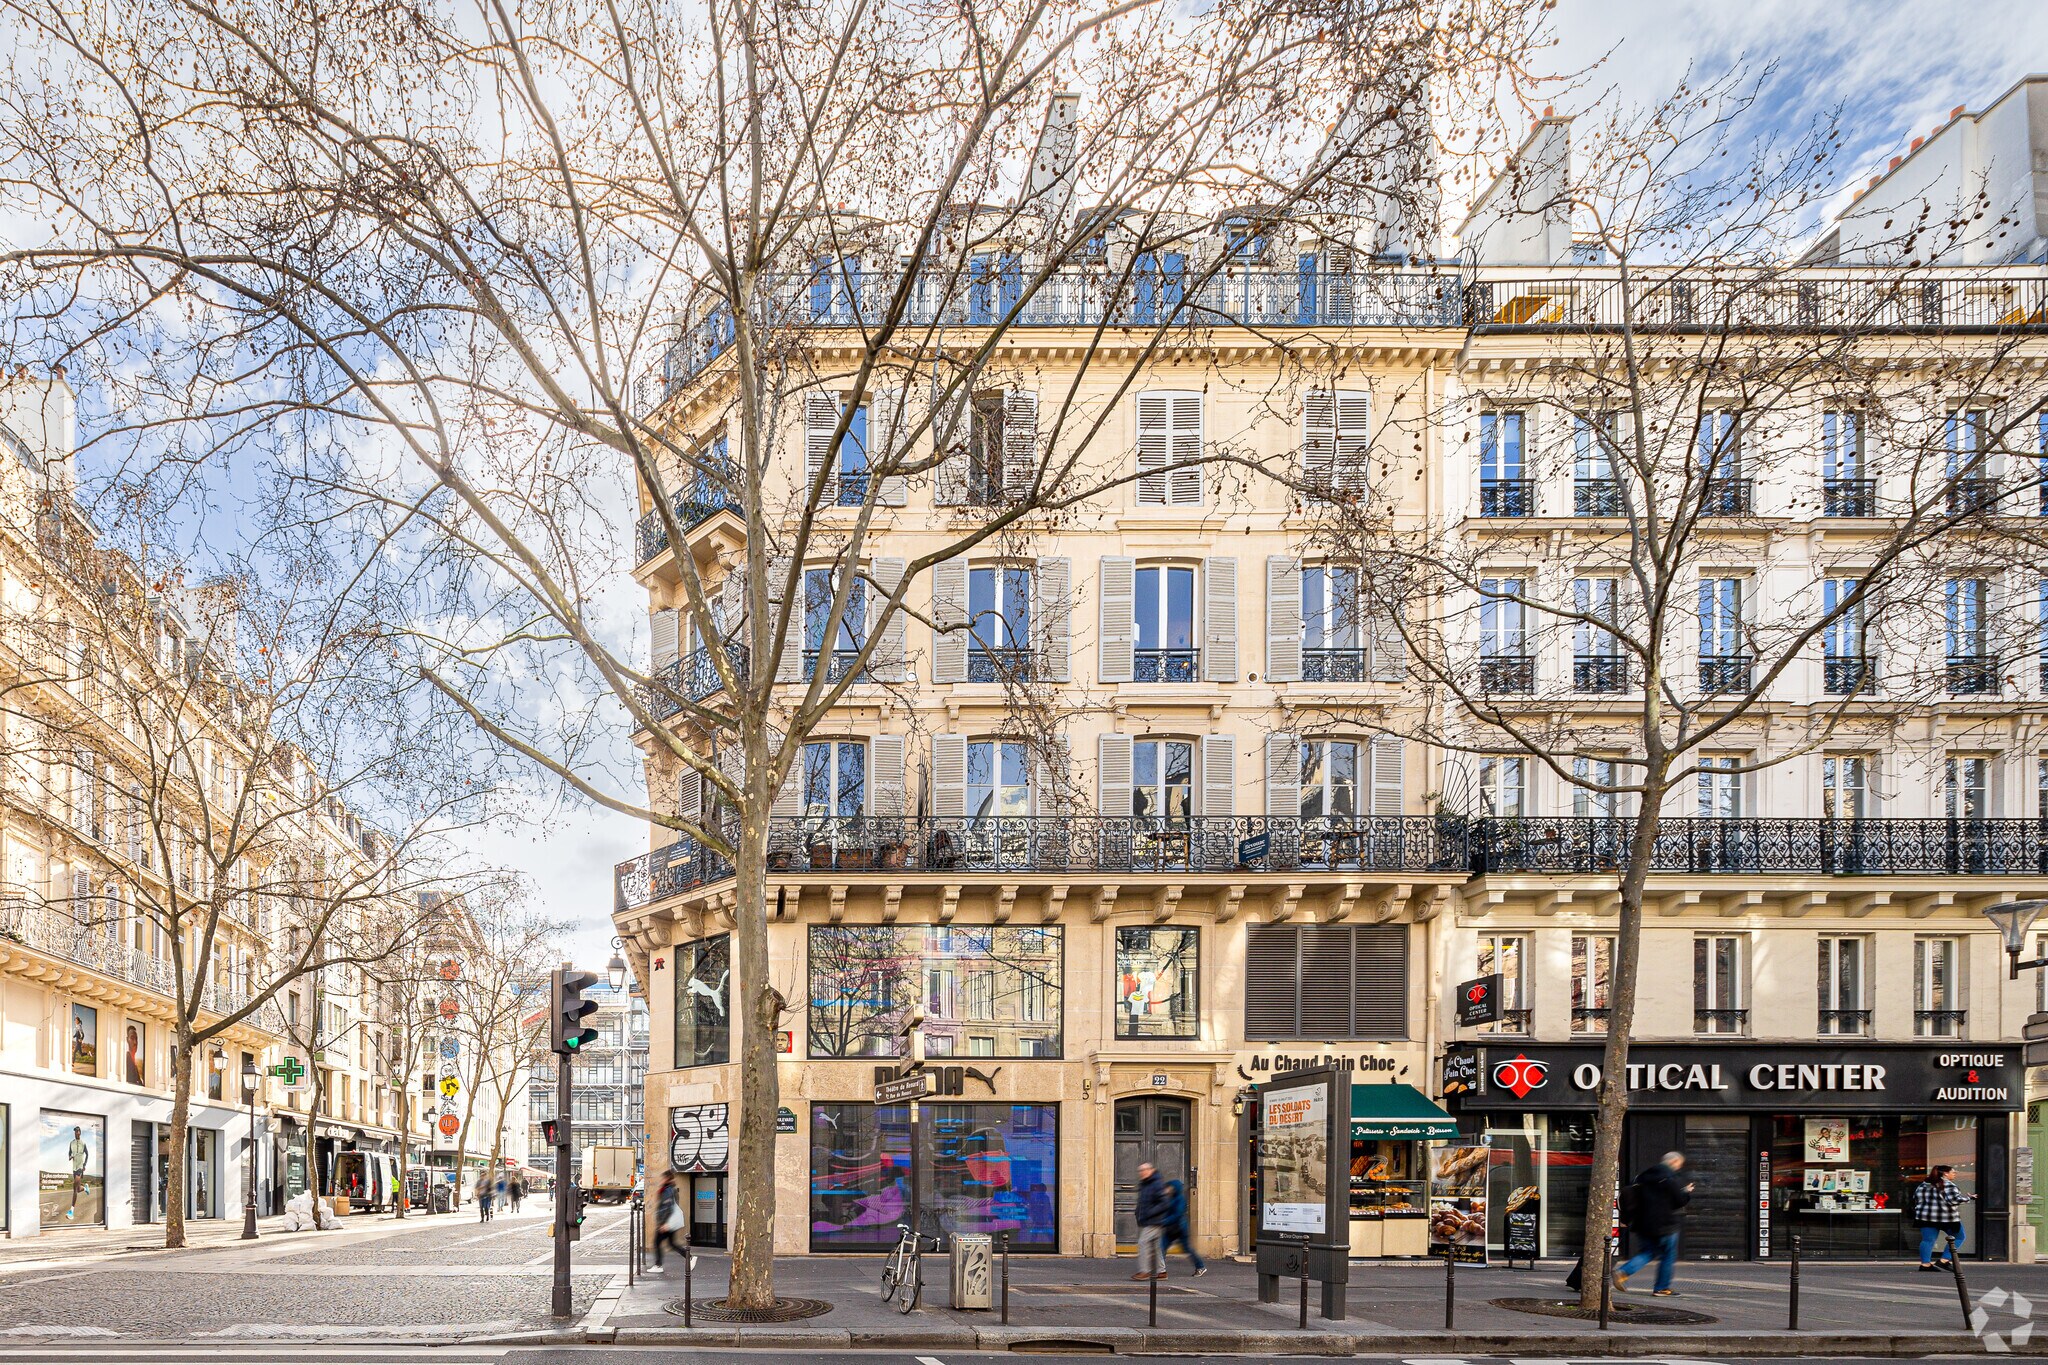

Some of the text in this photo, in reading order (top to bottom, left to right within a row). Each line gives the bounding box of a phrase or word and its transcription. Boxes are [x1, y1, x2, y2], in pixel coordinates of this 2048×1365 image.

[1251, 1055, 1396, 1071] Au Chaud Pain Choc
[1454, 1055, 1475, 1068] Chaud
[1939, 1054, 2005, 1067] OPTIQUE
[1460, 1065, 1477, 1078] Choc
[1573, 1063, 1887, 1091] OTICAL CENTER
[1967, 1069, 1980, 1083] &
[906, 1080, 919, 1089] Renard
[1154, 1076, 1166, 1085] 22
[1936, 1087, 2008, 1100] AUDITION
[1269, 1100, 1311, 1115] LES SOLDATS
[1269, 1115, 1279, 1125] DU
[1389, 1126, 1421, 1136] Sandwich
